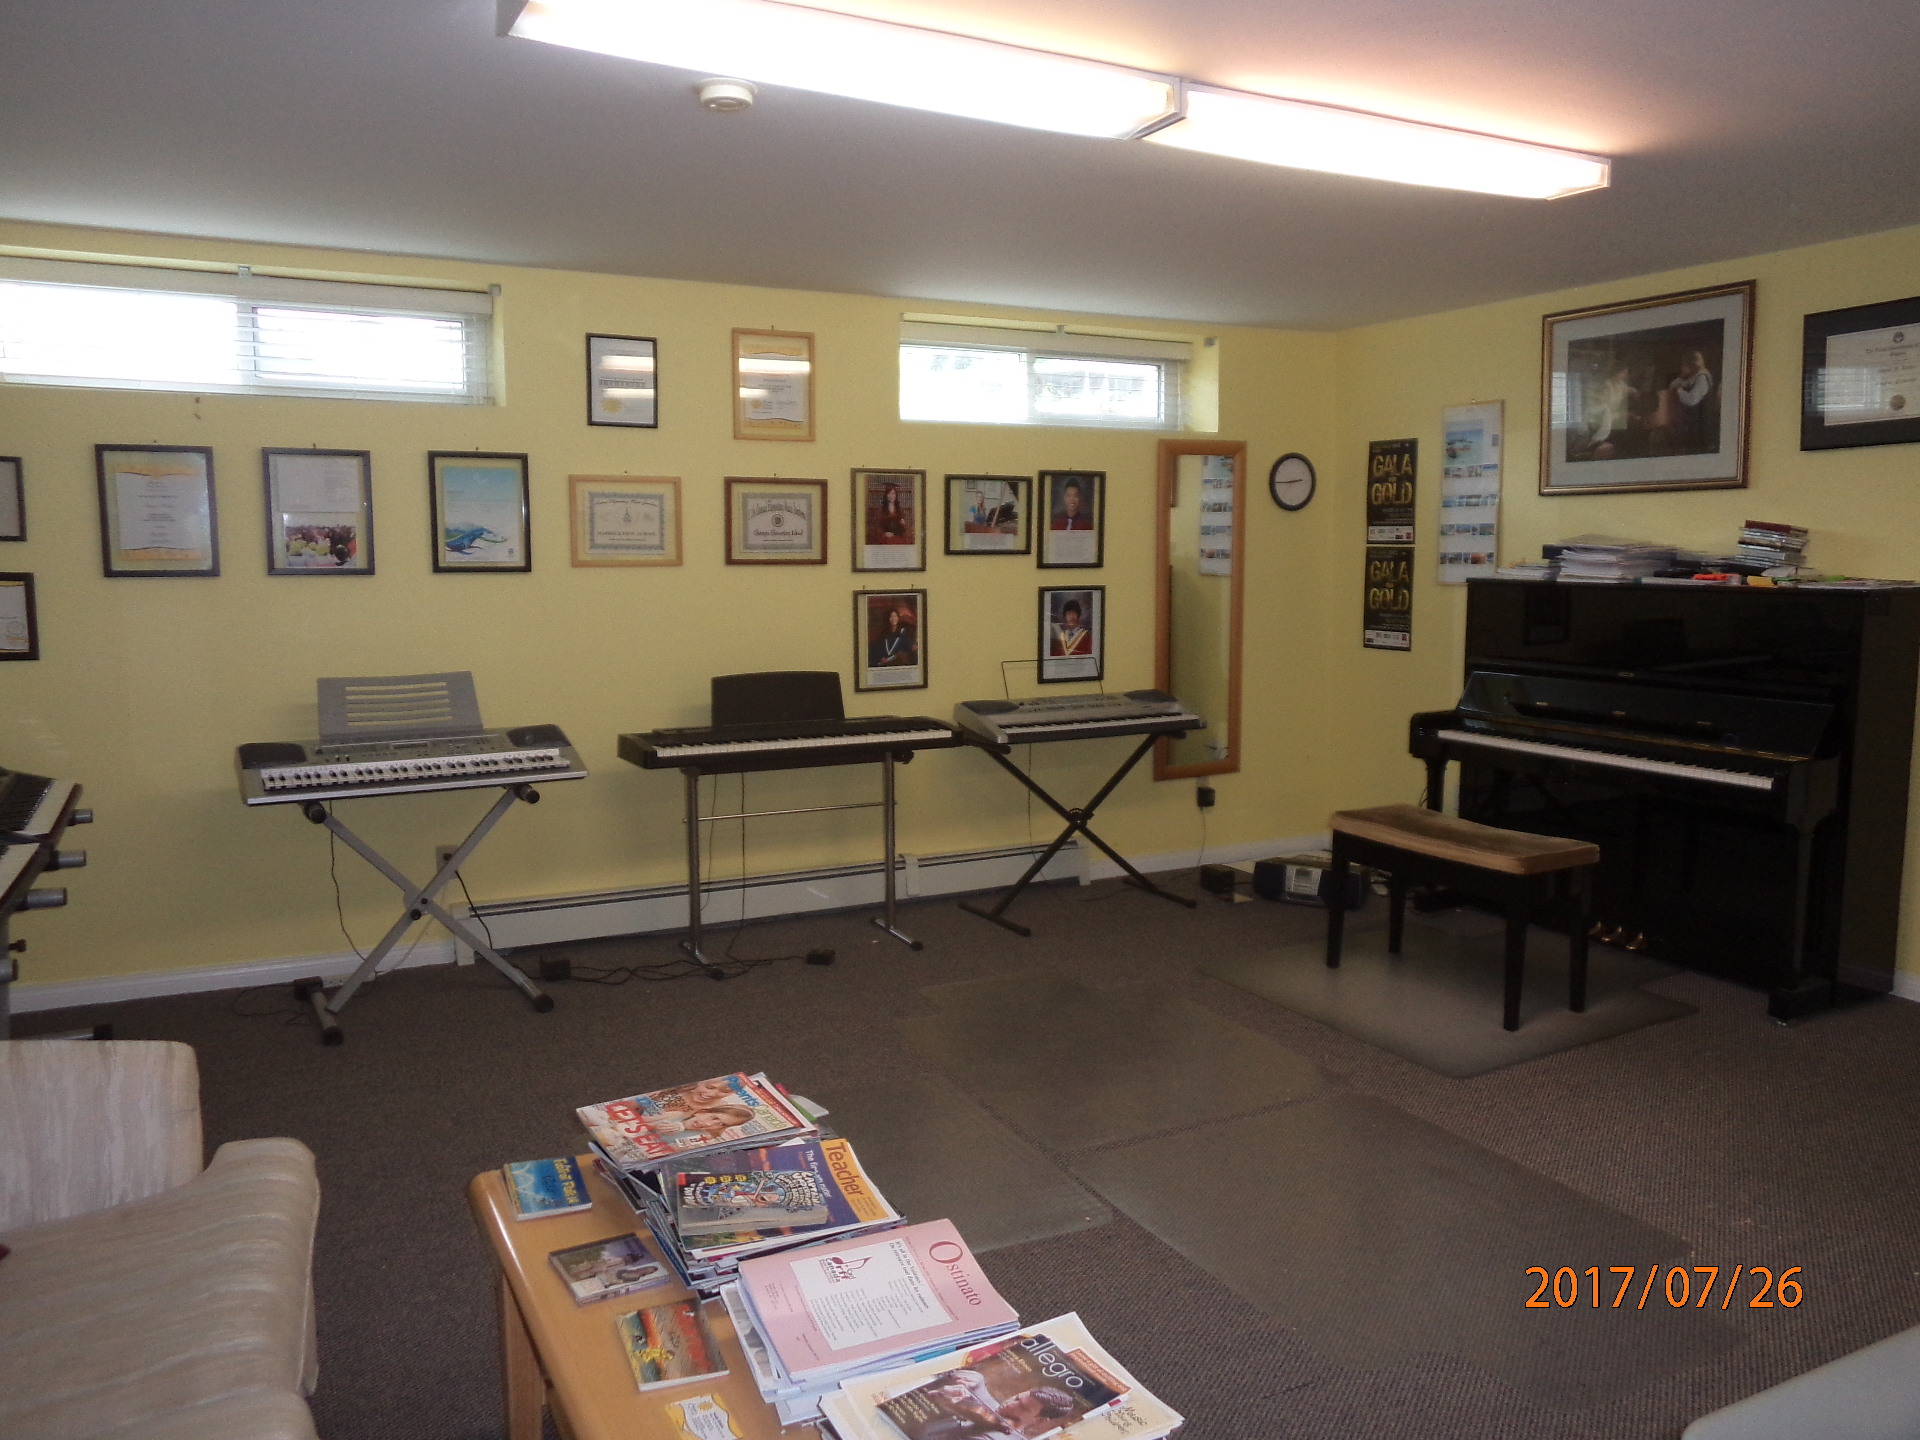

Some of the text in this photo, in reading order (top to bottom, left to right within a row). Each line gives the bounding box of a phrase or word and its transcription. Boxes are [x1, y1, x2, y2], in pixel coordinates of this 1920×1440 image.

[1373, 453, 1413, 478] GALA
[1372, 482, 1413, 505] GOLD
[1370, 560, 1409, 582] GALA
[1369, 587, 1409, 611] GOLD
[605, 1101, 651, 1136] LET'S
[805, 1150, 815, 1161] The
[826, 1142, 864, 1195] Teacher
[825, 1258, 841, 1282] Canada
[929, 1241, 982, 1306] Ostinato
[1021, 1339, 1084, 1388] allegro
